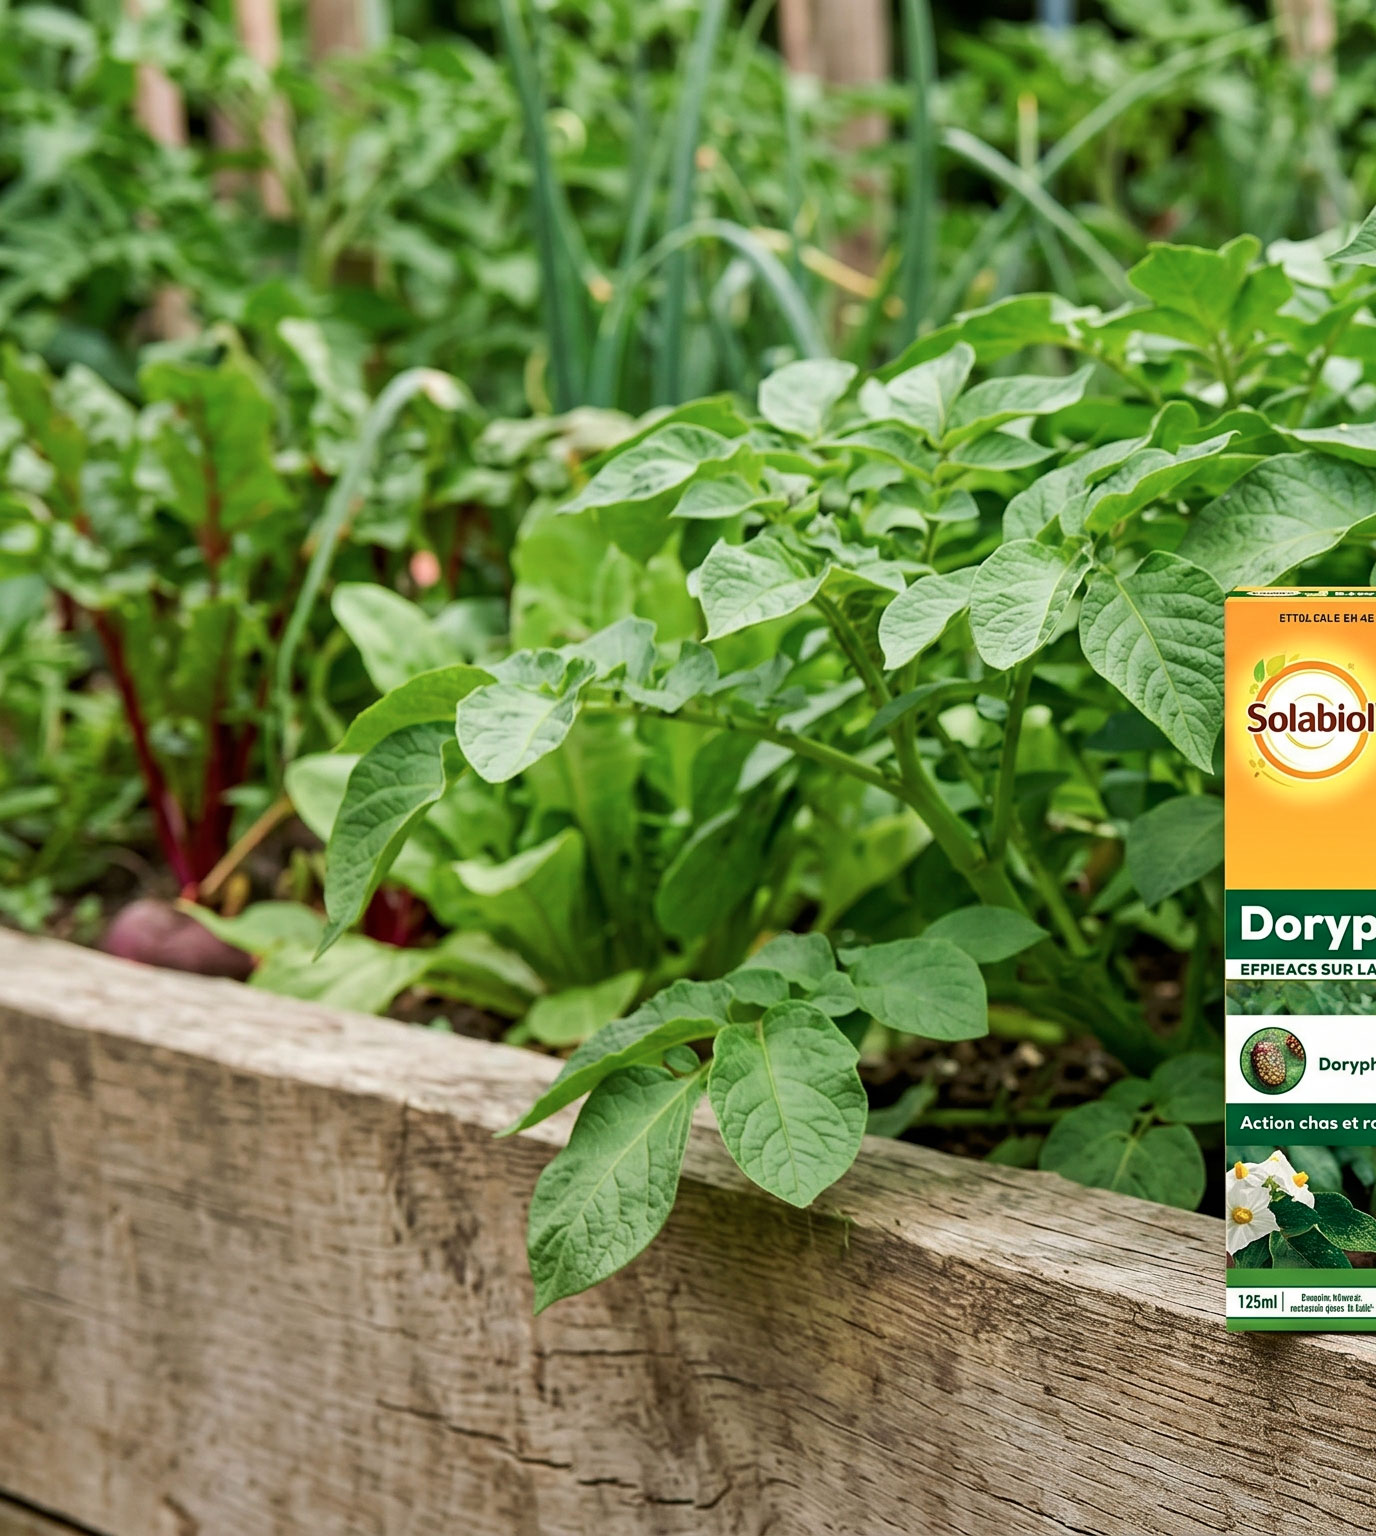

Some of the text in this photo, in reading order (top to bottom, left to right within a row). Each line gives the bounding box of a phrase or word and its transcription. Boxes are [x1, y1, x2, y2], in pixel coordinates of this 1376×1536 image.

[1247, 703, 1375, 733] Solabiol
[1240, 963, 1318, 976] EFPIEACS
[1321, 963, 1353, 976] SUR
[1240, 1115, 1295, 1130] Action
[1342, 1116, 1359, 1130] et
[1238, 1294, 1278, 1309] 125ml
